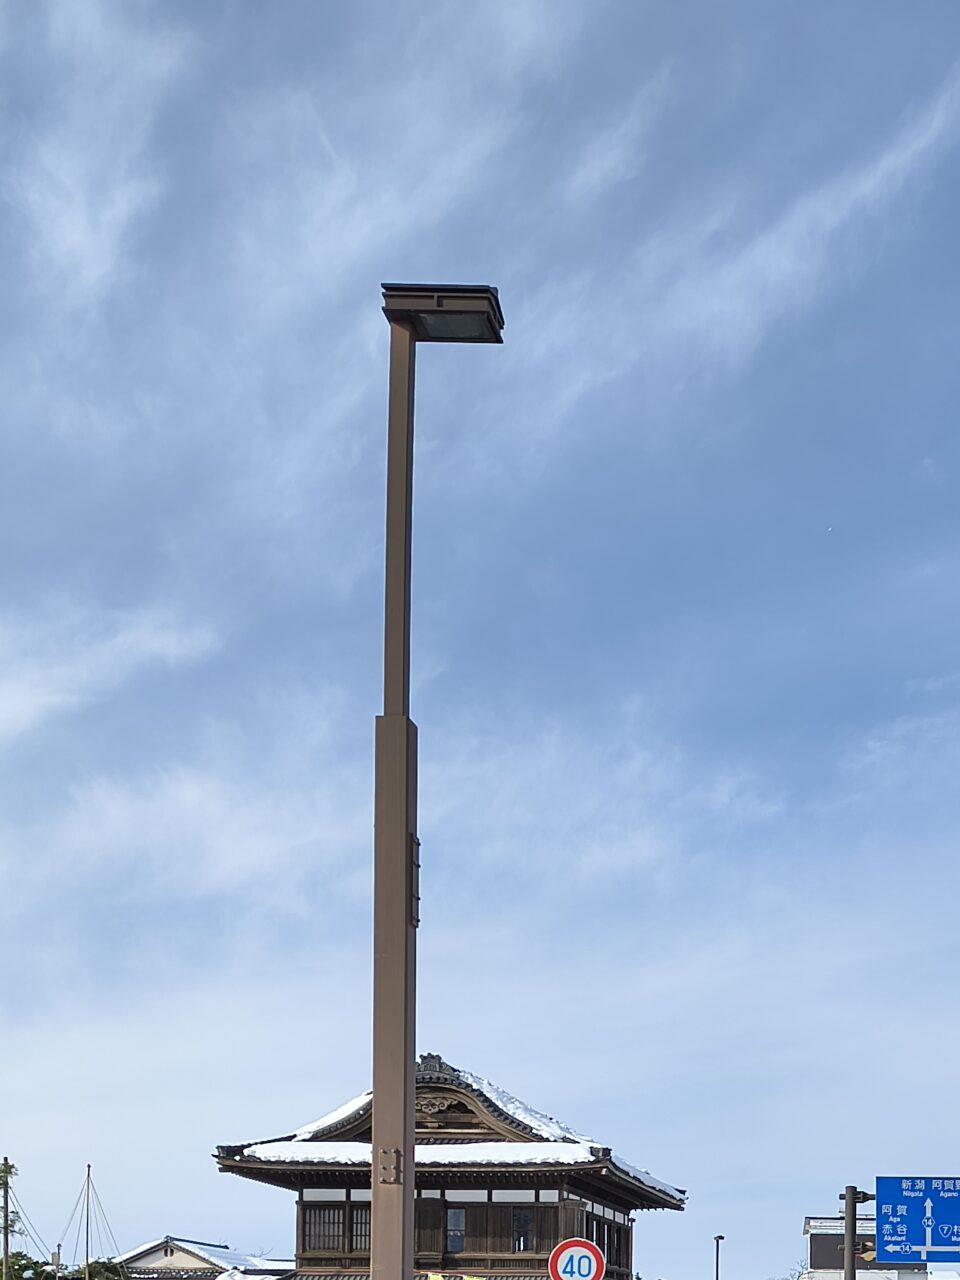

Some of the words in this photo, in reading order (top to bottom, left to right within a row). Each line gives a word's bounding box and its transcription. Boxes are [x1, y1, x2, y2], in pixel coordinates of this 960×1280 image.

[901, 1179, 925, 1190] 新潟
[881, 1204, 908, 1216] 阿賀
[882, 1224, 908, 1235] 赤谷
[562, 1254, 592, 1278] 40
